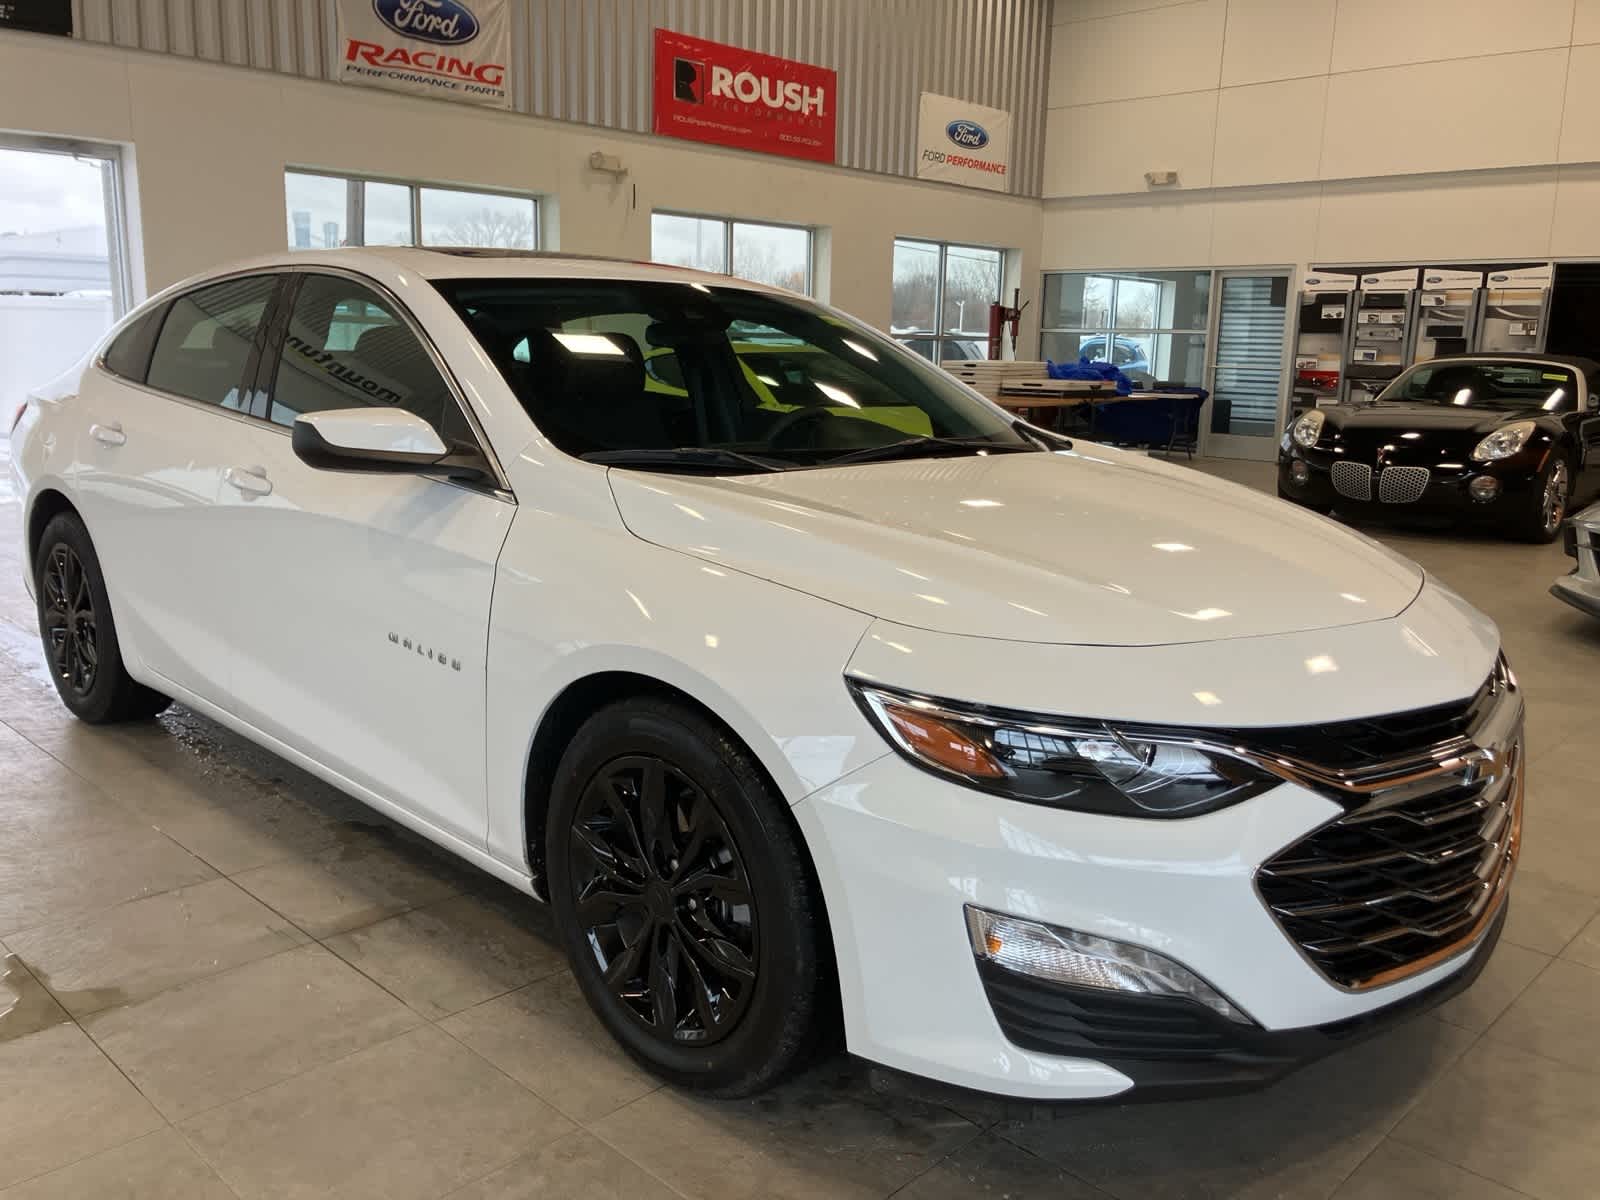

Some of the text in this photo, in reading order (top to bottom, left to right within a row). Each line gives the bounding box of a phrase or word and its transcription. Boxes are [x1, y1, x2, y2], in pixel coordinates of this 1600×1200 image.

[394, 0, 460, 38] Ford
[346, 39, 505, 86] RACING
[346, 65, 505, 97] PERFORMANCE PARTS
[711, 66, 825, 117] ROUSH
[954, 124, 981, 145] Ford
[922, 149, 1007, 175] FORD PERFORMANCE
